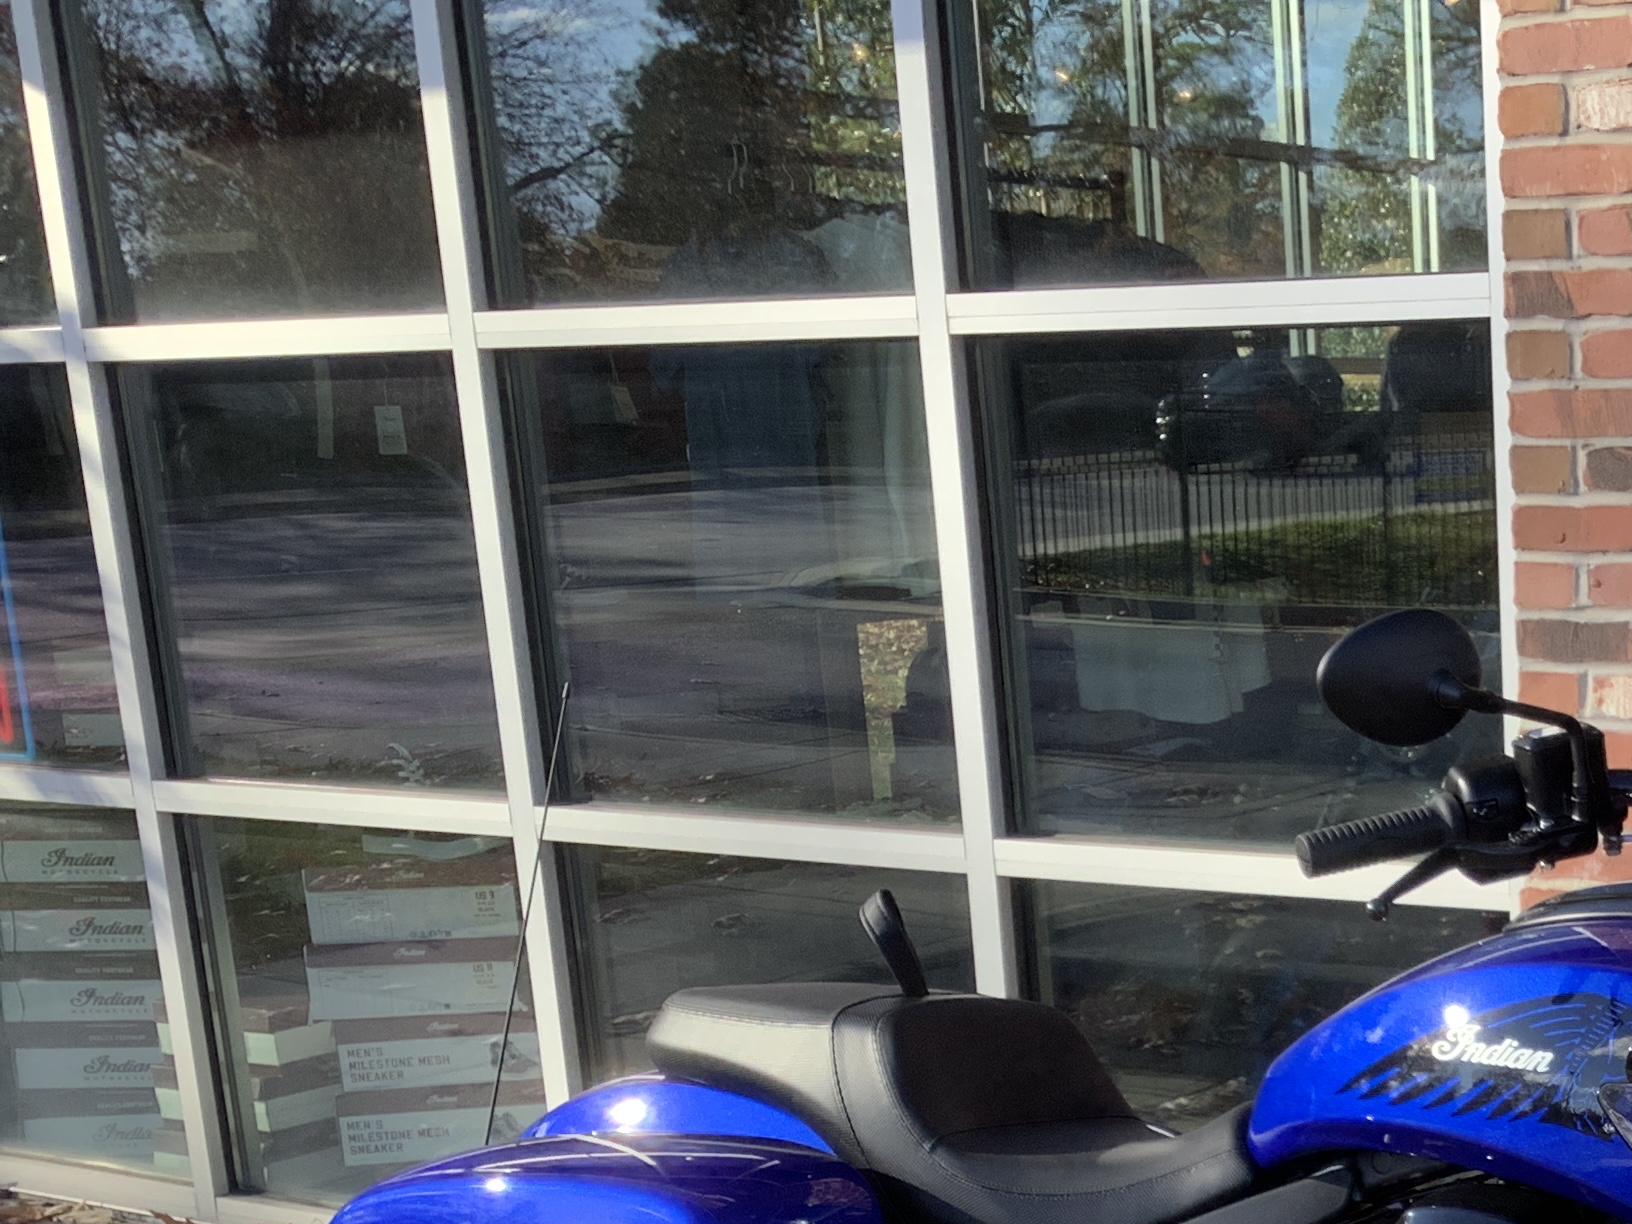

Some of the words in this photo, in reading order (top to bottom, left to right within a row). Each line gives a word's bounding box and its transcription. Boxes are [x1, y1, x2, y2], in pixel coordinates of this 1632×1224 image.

[41, 847, 116, 868] Indian
[69, 916, 144, 936] Indian
[70, 987, 146, 1007] Indian
[346, 1047, 383, 1058] MEN'S
[1431, 1024, 1554, 1073] Indian
[349, 1057, 414, 1071] MILESTONE
[418, 1054, 450, 1066] MESH
[350, 1072, 404, 1083] SNEAKER
[346, 1120, 383, 1131] MEN'S
[347, 1130, 414, 1143] MILESTONE
[350, 1143, 404, 1155] SNEAKER
